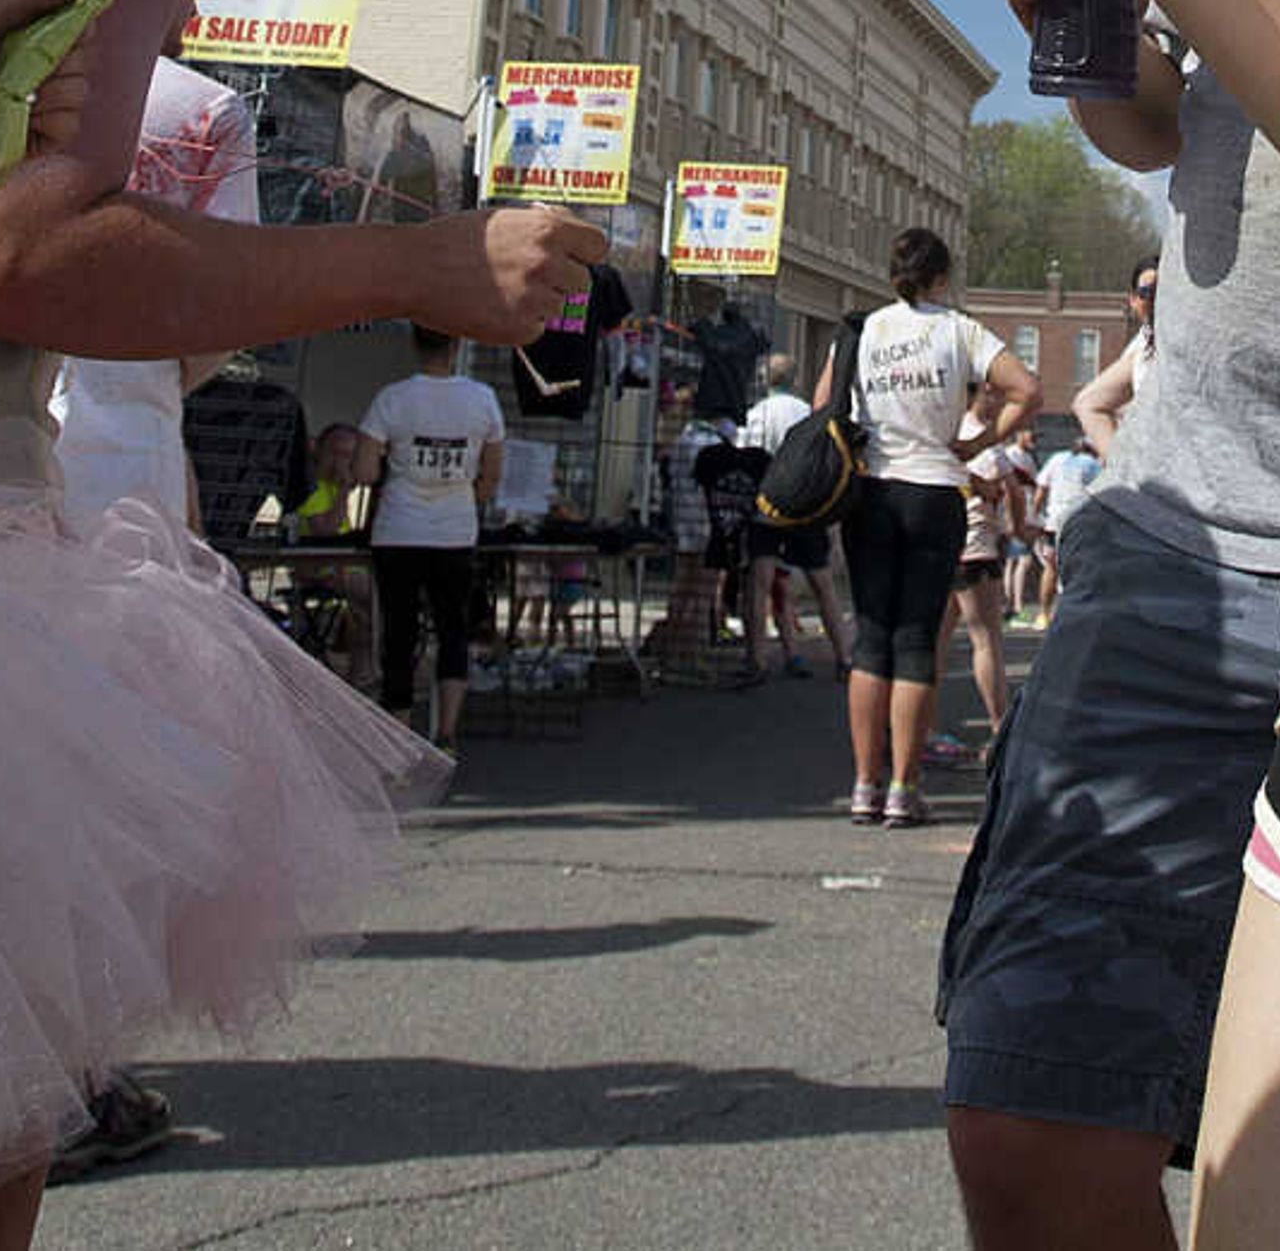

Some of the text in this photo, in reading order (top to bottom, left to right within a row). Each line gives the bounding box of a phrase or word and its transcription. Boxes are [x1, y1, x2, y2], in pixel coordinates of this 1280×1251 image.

[206, 17, 259, 44] SALE
[265, 21, 335, 48] TODAY
[505, 66, 635, 90] MERCHANDISE
[493, 166, 516, 184] ON
[521, 167, 558, 187] SALE
[562, 169, 615, 191] TODAY
[682, 166, 784, 186] MERCHANDISE
[866, 368, 950, 394] ASPHALT
